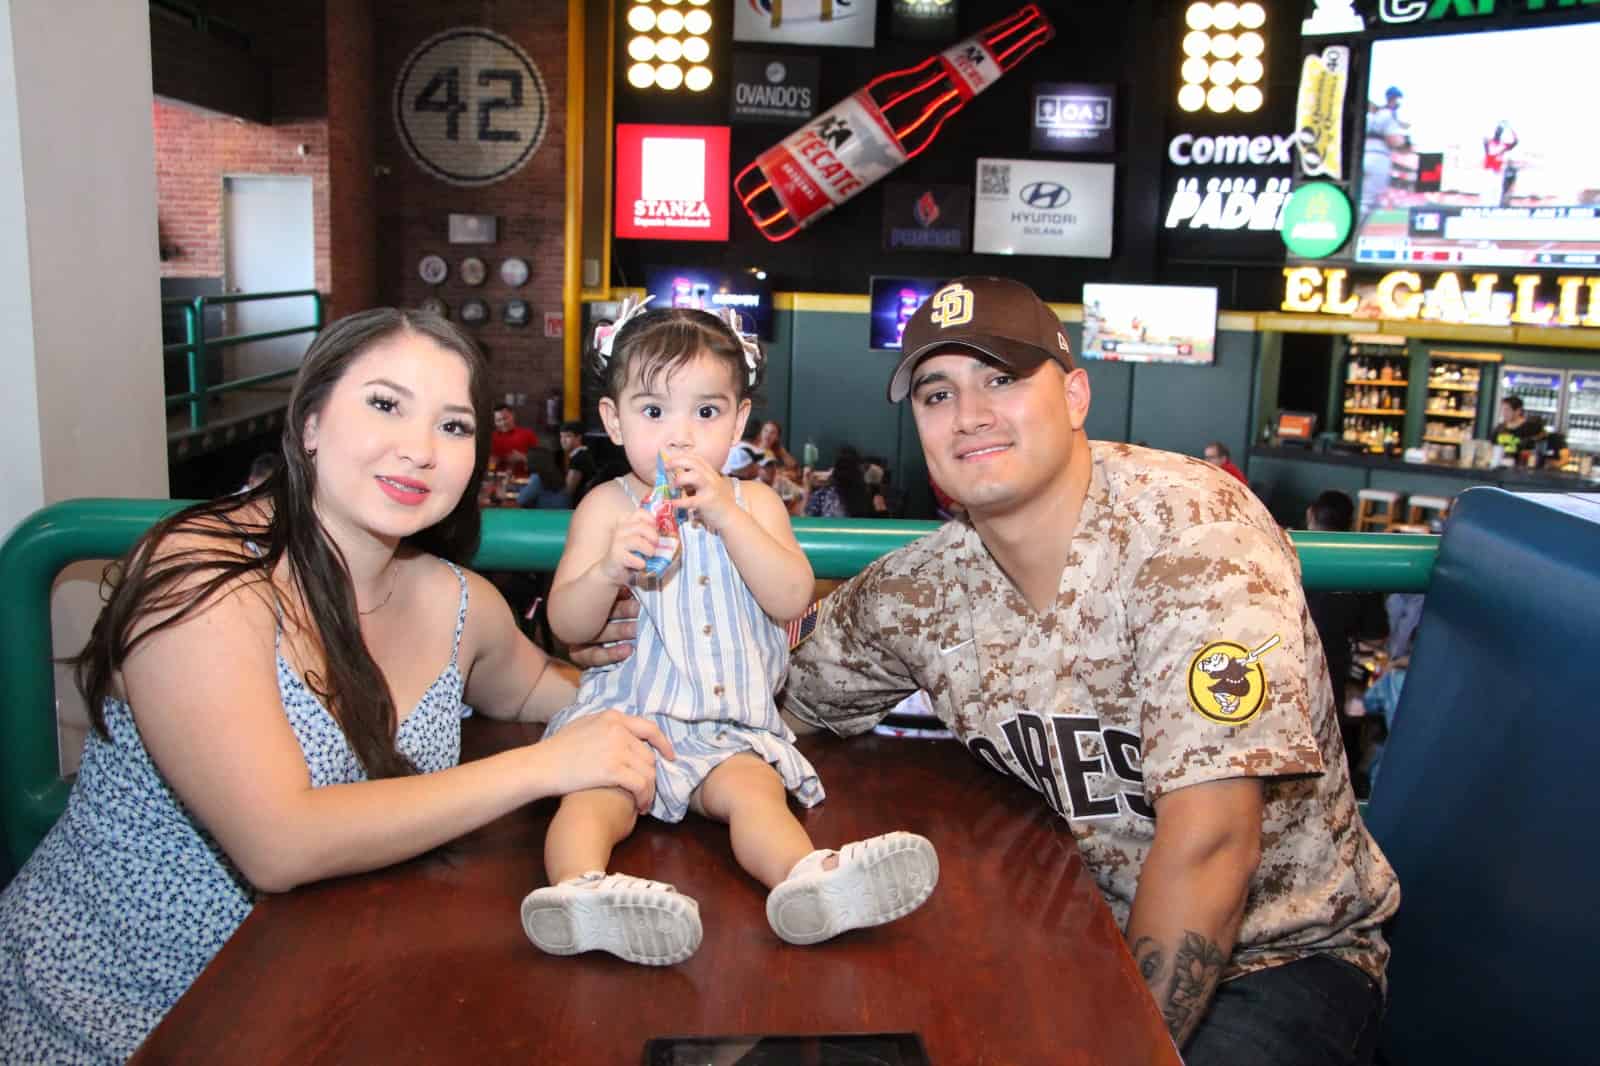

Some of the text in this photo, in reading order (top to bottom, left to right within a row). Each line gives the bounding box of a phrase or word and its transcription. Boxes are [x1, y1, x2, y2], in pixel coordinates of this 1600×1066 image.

[413, 65, 524, 143] 42
[736, 83, 811, 108] OVANDO'S
[798, 131, 862, 196] TECATE
[633, 200, 711, 217] STANZA
[1010, 212, 1077, 225] HYUNDAI
[931, 282, 974, 328] SD
[1281, 266, 1360, 315] EL
